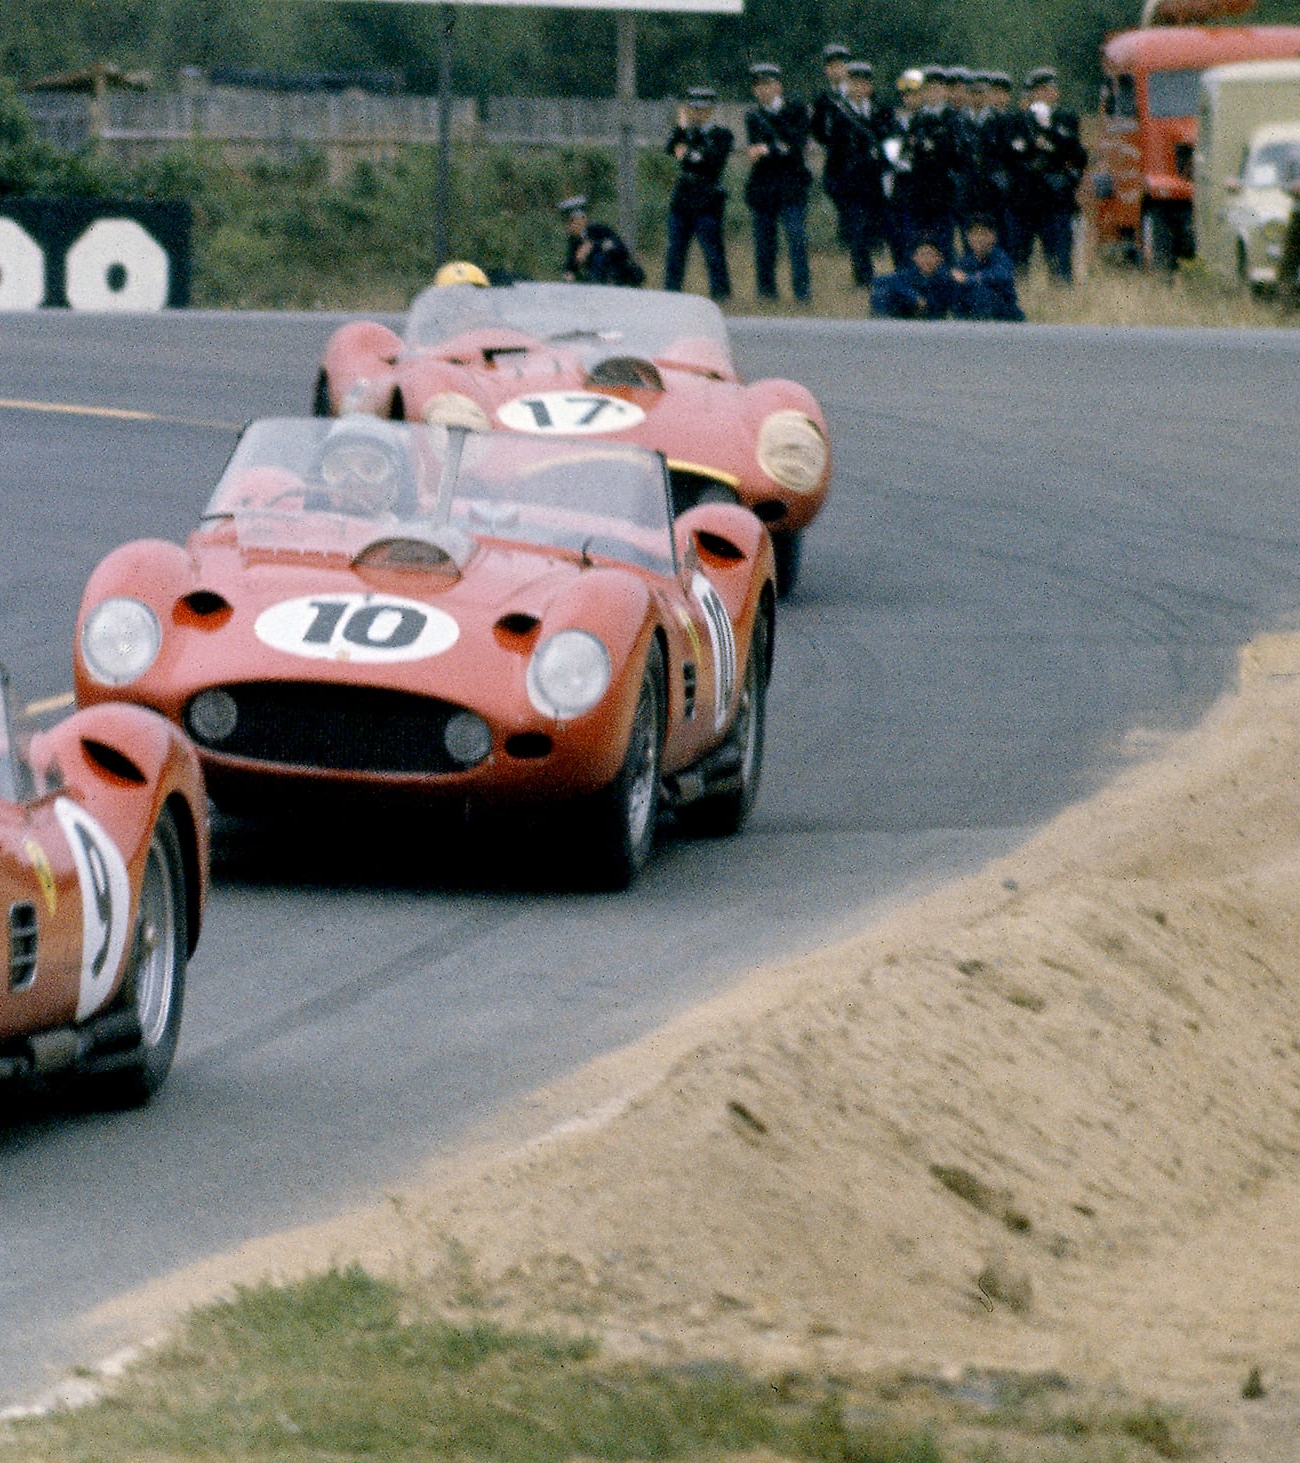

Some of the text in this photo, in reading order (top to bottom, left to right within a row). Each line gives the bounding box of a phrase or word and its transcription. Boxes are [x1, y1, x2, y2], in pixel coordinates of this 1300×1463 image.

[520, 397, 611, 428] 17
[302, 602, 428, 649] 10
[73, 821, 112, 981] 9
